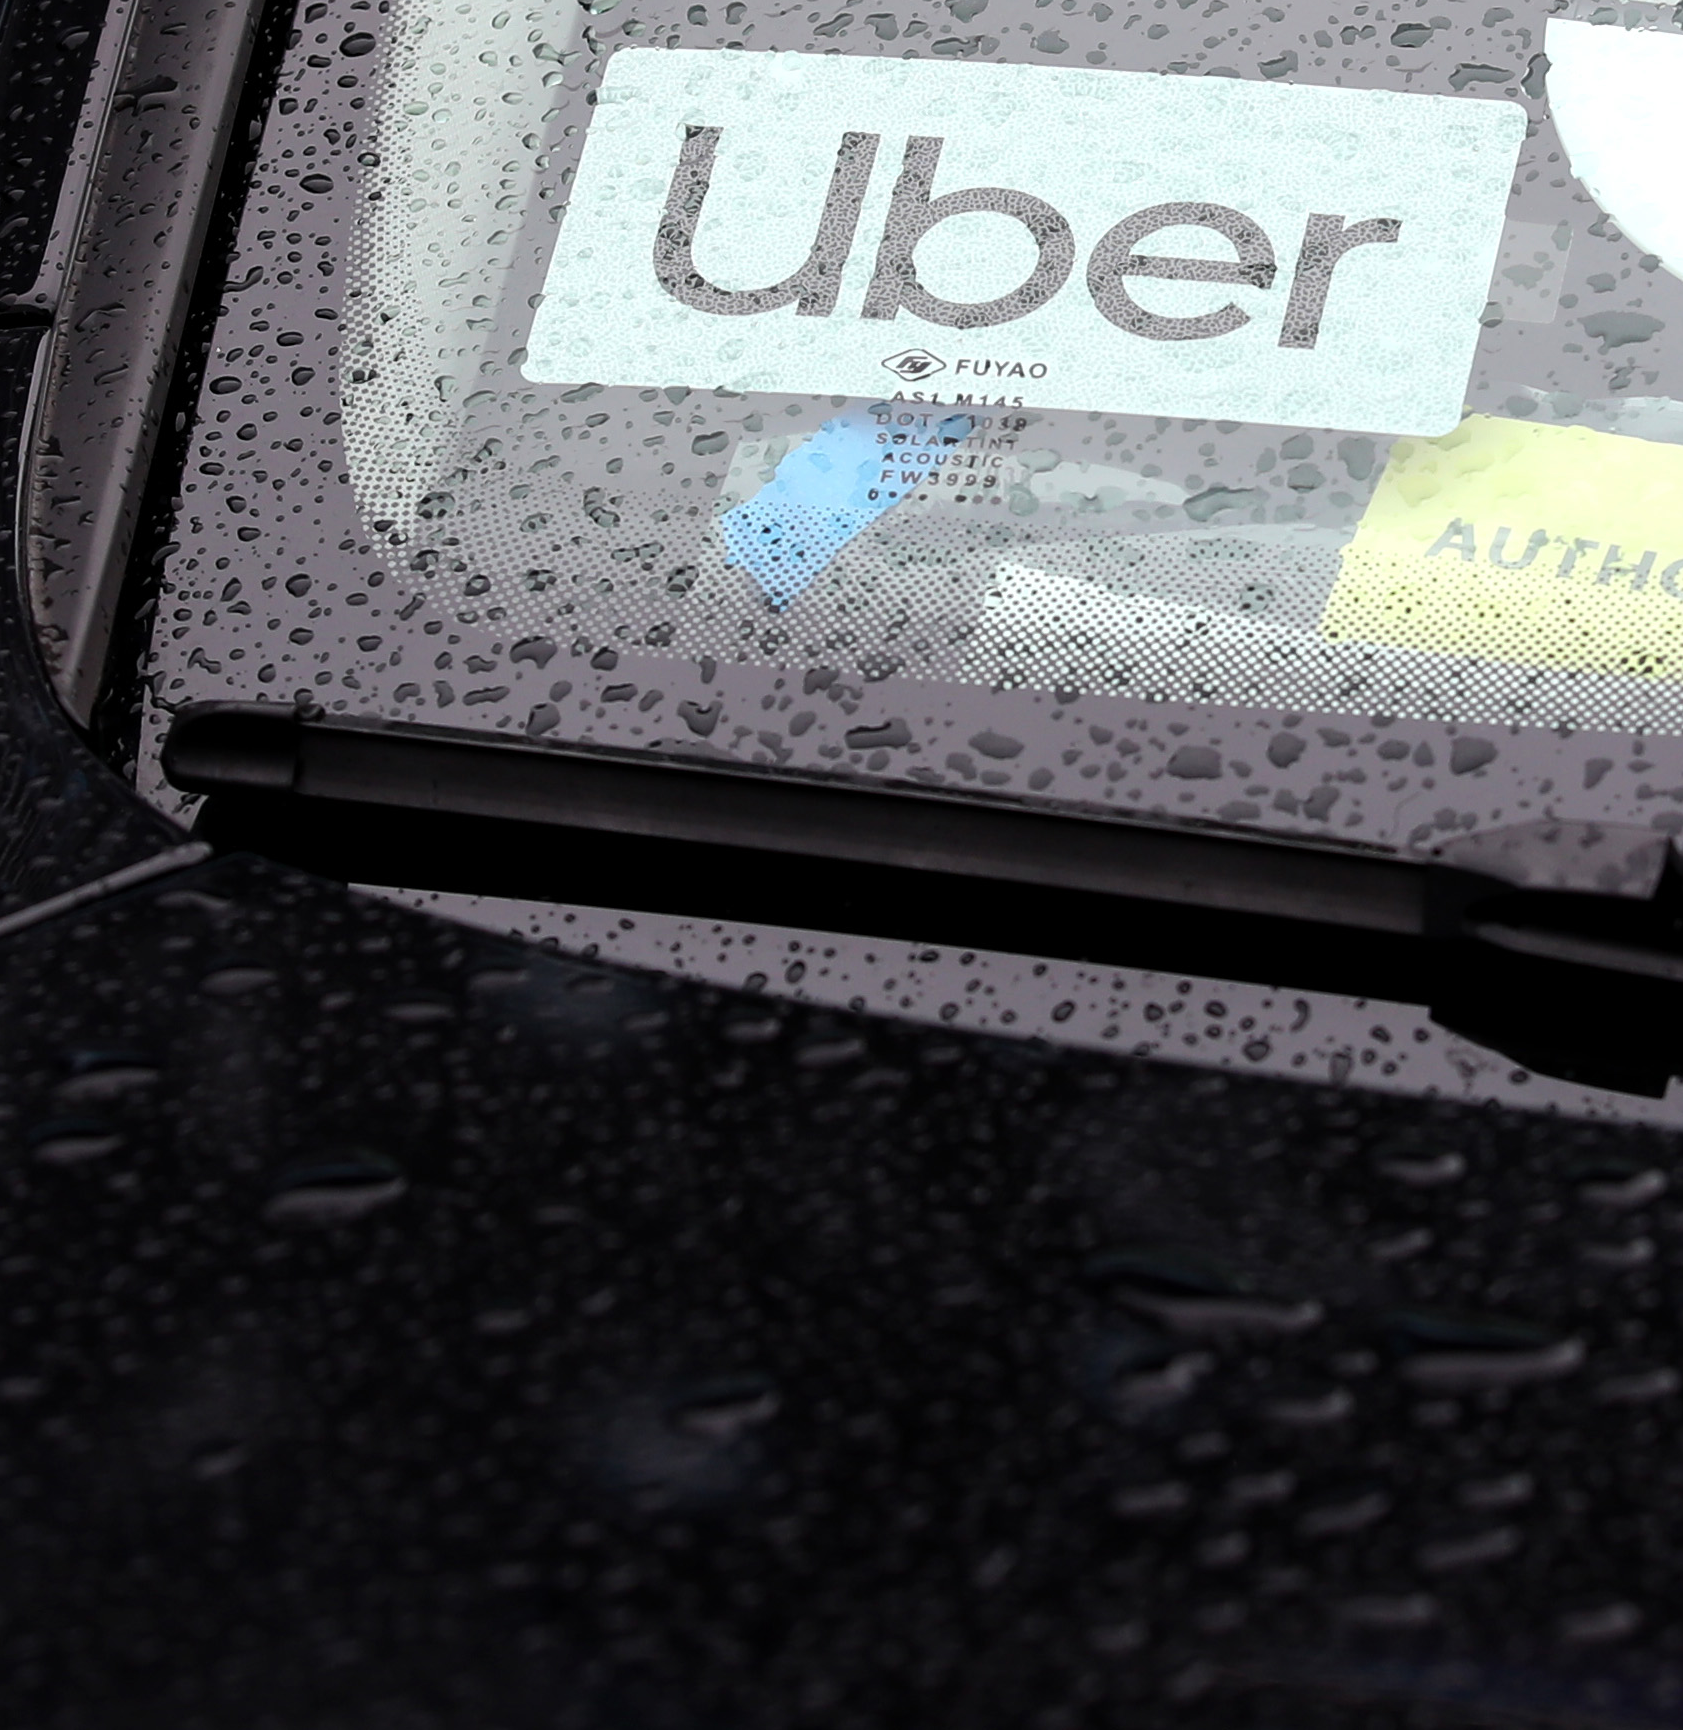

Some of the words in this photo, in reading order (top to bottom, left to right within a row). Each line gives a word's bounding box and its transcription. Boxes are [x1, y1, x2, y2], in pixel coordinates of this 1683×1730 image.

[652, 124, 1403, 349] Uber
[954, 358, 1048, 379] FUYAO
[954, 392, 1024, 409] M145
[875, 412, 934, 427] DOT
[881, 451, 1004, 468] ACOUSTIC
[879, 469, 997, 488] FW3999
